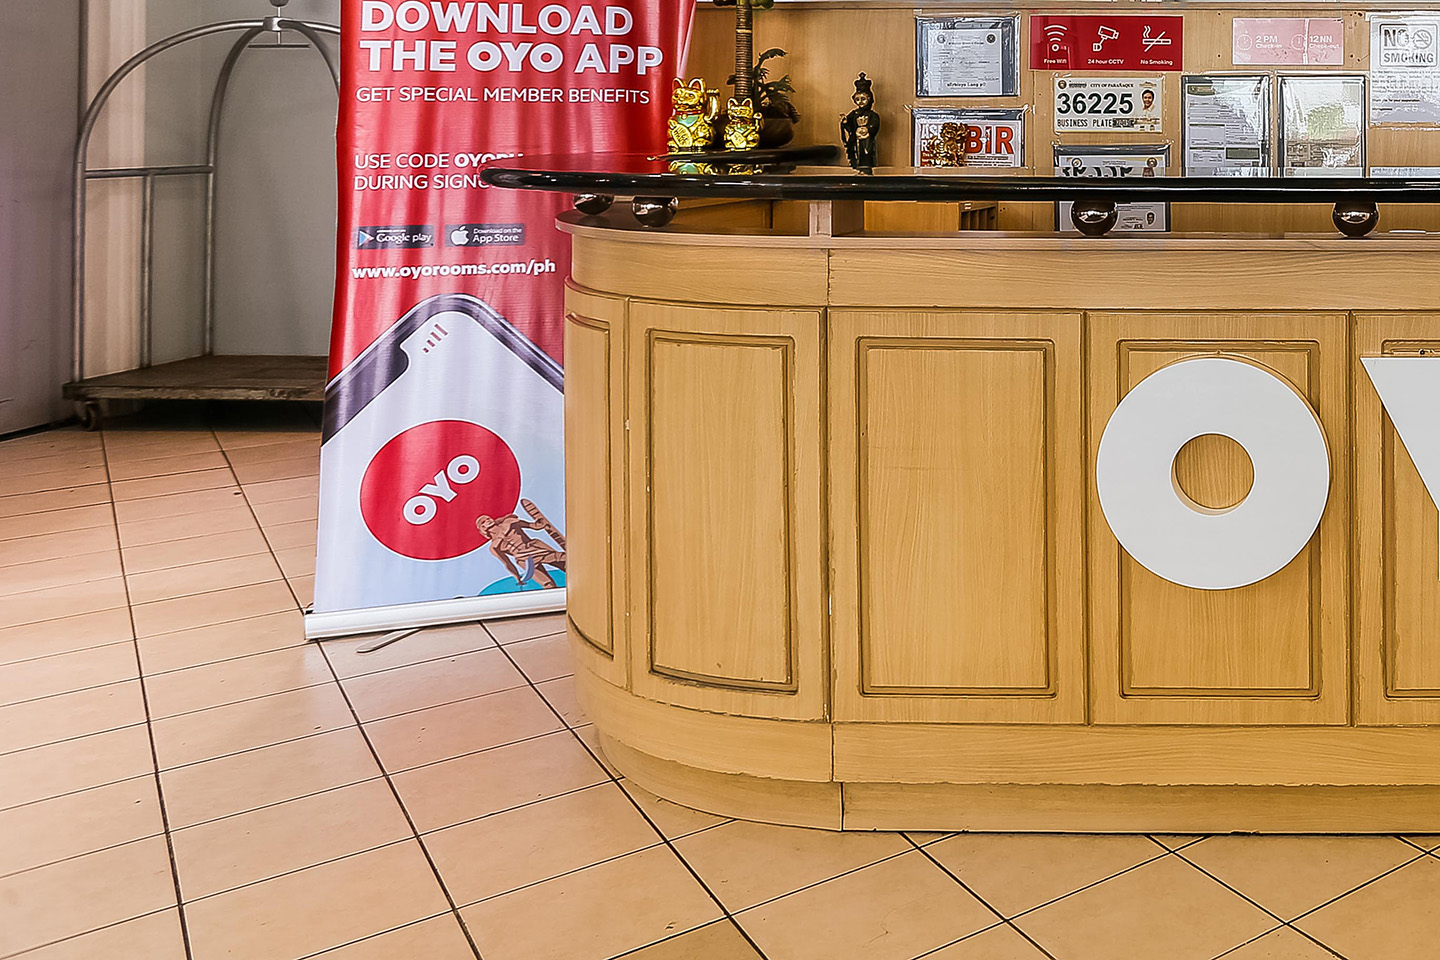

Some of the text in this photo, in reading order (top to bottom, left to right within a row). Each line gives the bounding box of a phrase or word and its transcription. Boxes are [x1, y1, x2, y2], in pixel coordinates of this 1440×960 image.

[360, 0, 633, 36] DOWNLOAD
[1255, 35, 1278, 43] 2 PM
[1309, 35, 1333, 43] 12 NN
[1384, 28, 1410, 47] NO
[359, 40, 664, 76] THE OYO APP
[1383, 52, 1434, 63] SMOKING
[356, 87, 650, 105] GET SPECIAL MEMBER BENEFITS
[1057, 93, 1134, 115] 36225
[1057, 119, 1088, 128] BUSINESS
[1092, 119, 1113, 128] PLATE
[965, 125, 1014, 154] BIR
[354, 153, 391, 169] USE
[396, 153, 450, 169] CODE
[354, 175, 428, 190] DURING
[376, 232, 433, 245] Google play
[473, 233, 519, 244] App Store
[351, 259, 556, 280] www.oyorooms.com/ph
[402, 453, 480, 525] OYO
